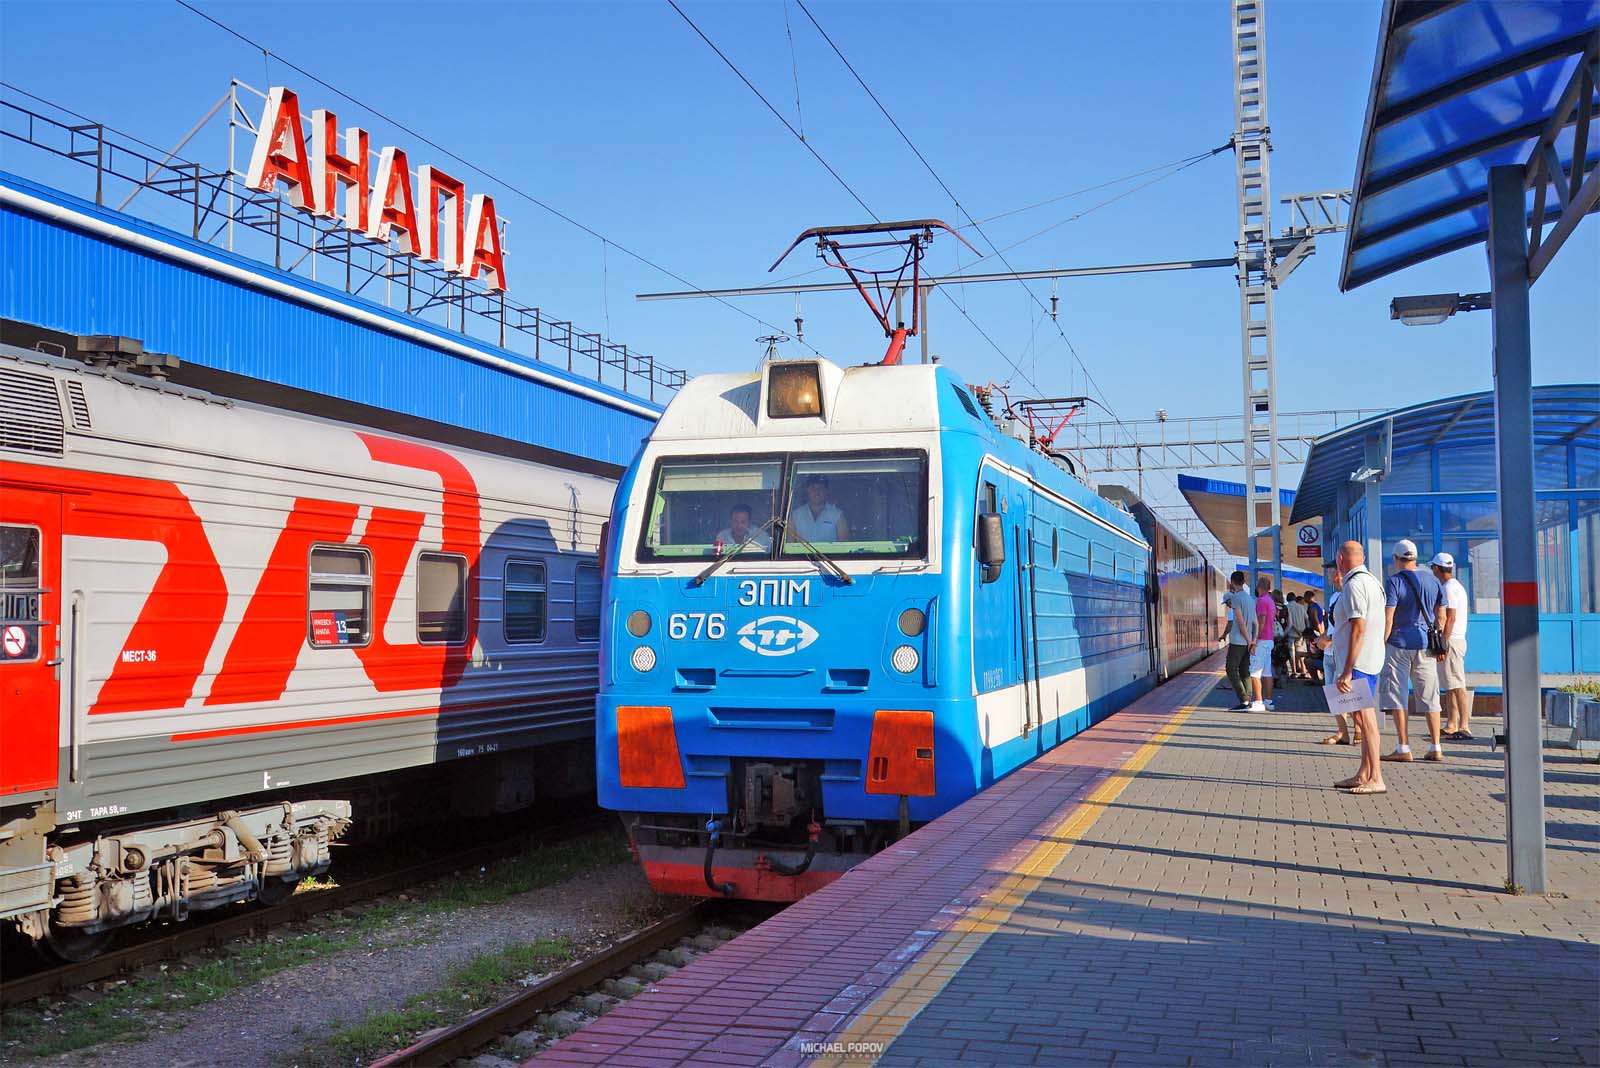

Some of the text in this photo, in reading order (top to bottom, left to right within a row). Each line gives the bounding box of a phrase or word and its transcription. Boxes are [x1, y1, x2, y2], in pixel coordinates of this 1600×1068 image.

[245, 86, 509, 292] АНАПА
[335, 620, 347, 634] 13
[668, 613, 726, 640] 676
[122, 650, 157, 663] МЕСТ-36
[90, 806, 108, 817] ТАРА
